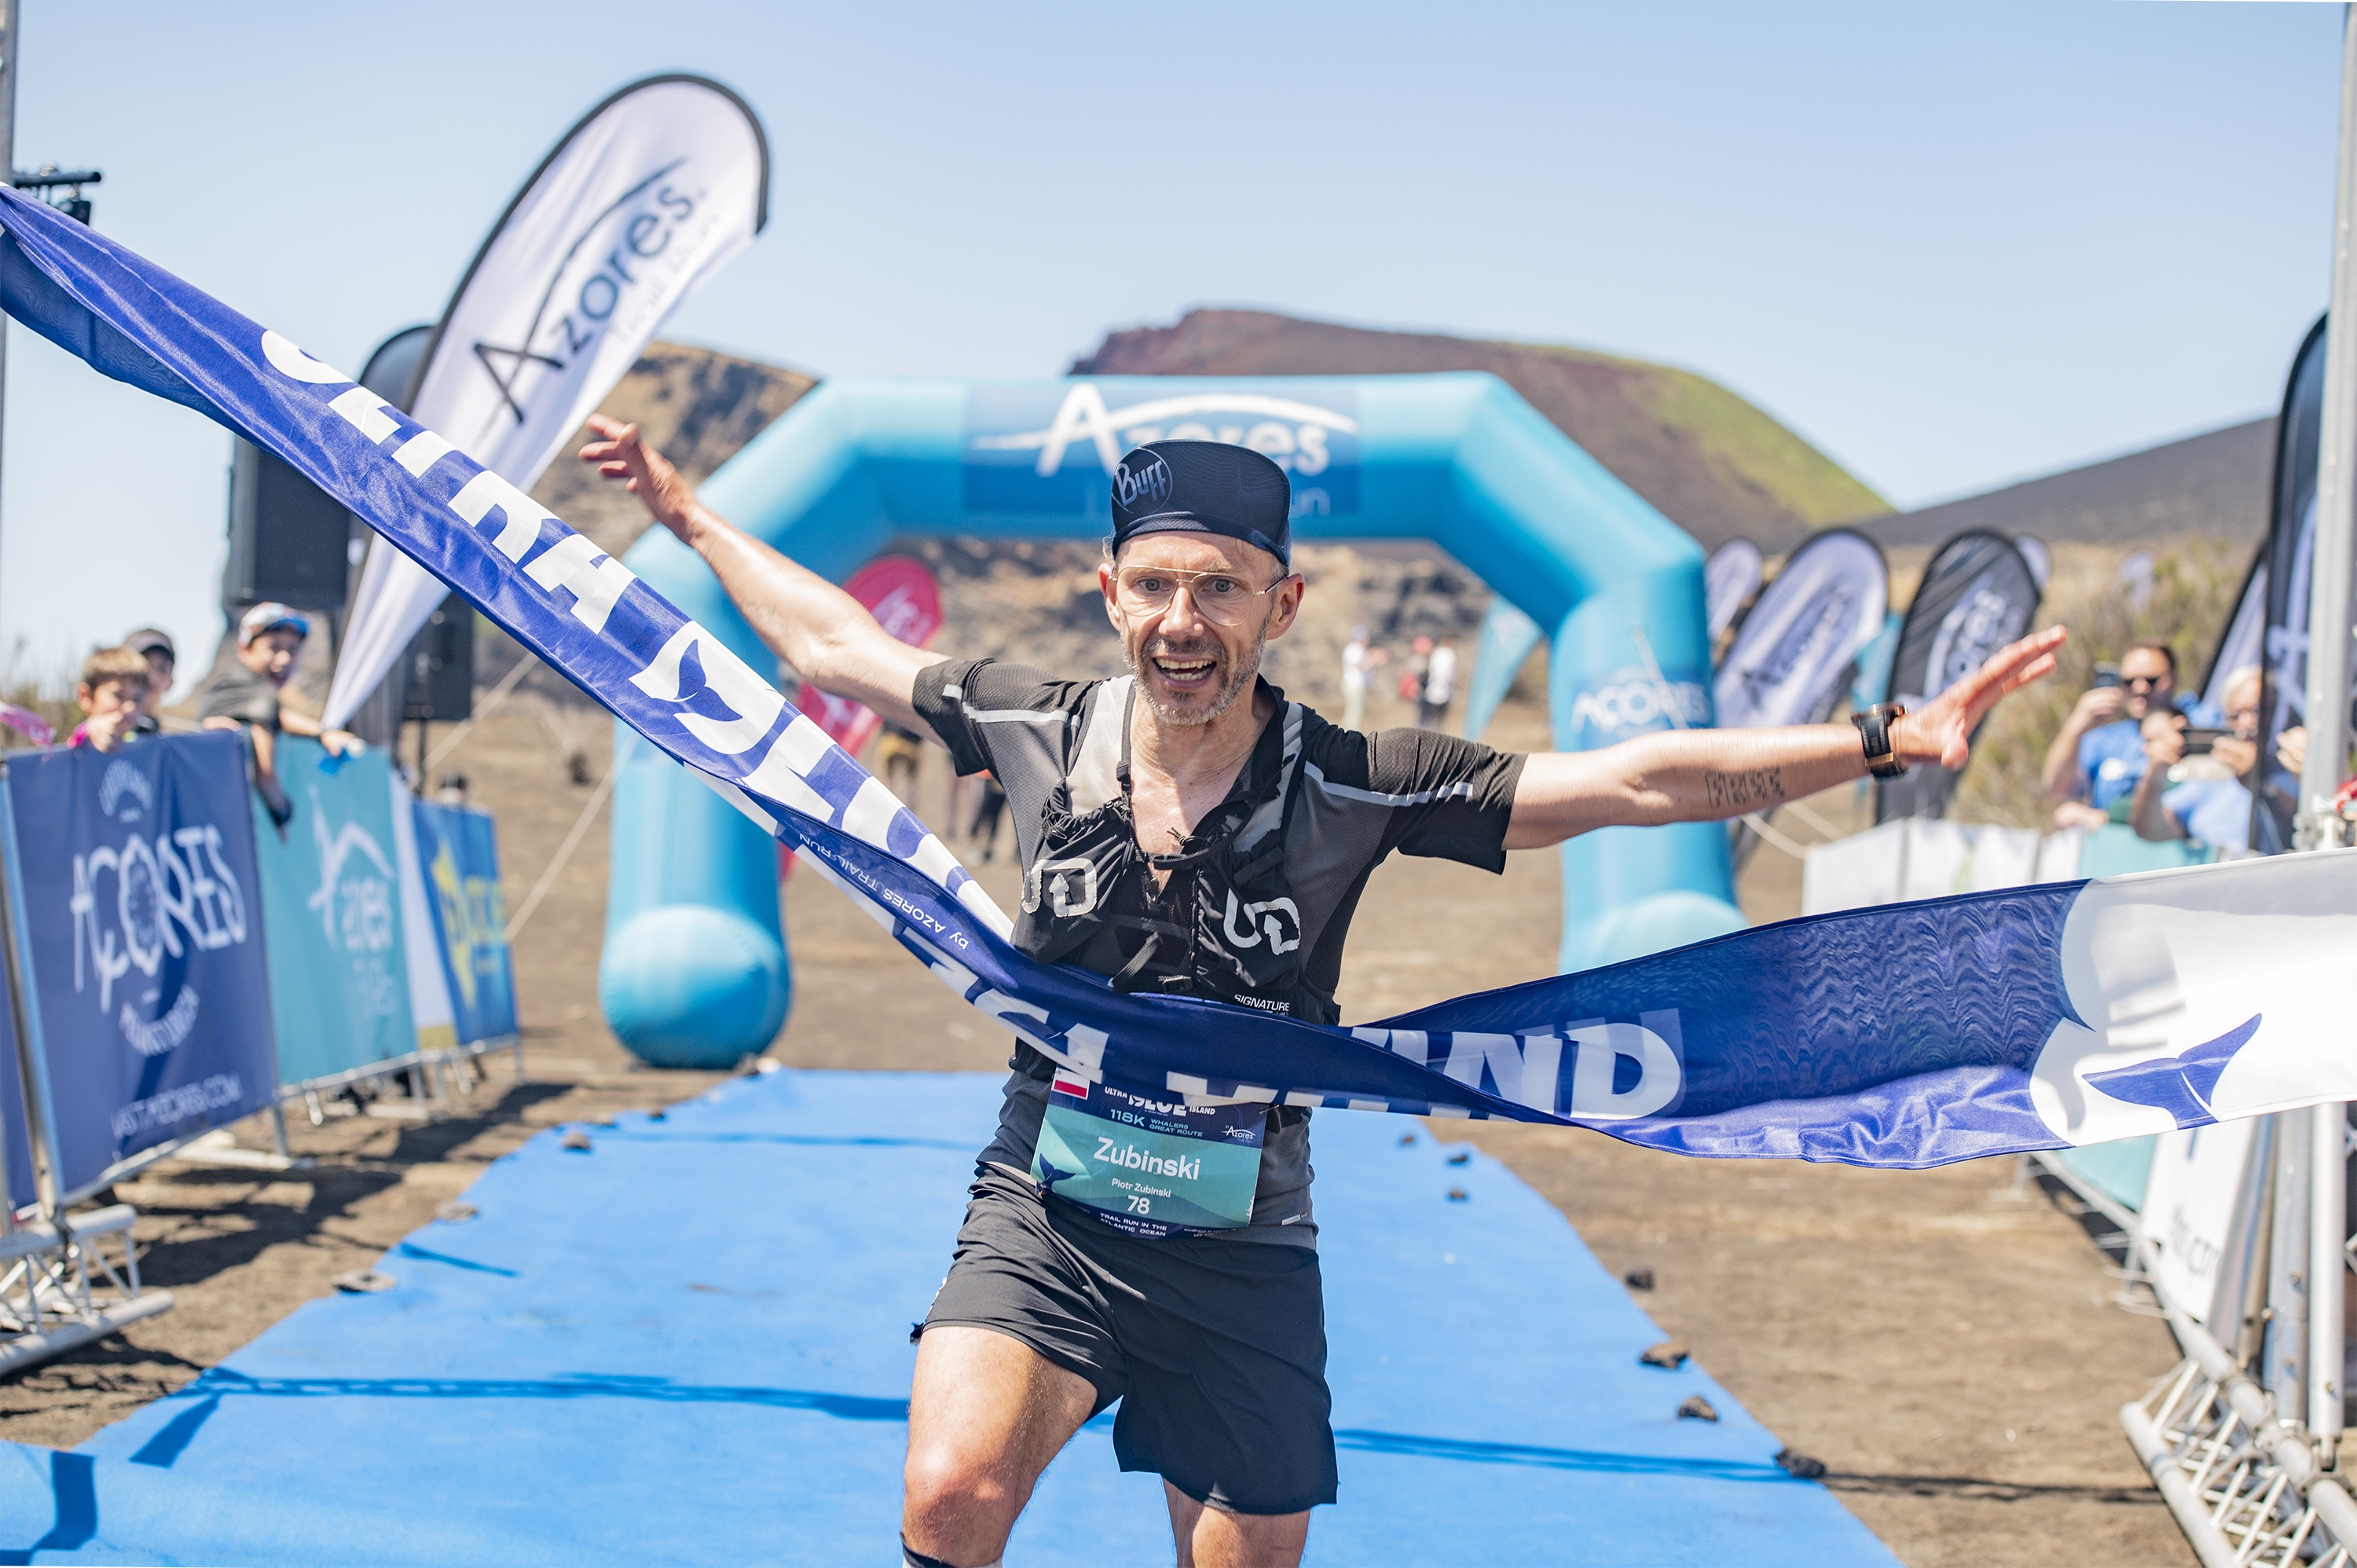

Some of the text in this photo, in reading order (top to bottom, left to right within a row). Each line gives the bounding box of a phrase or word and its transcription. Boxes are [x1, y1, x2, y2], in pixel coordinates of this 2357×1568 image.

[799, 833, 970, 951] by AZORES TRAIL RUN
[1234, 994, 1290, 1012] SIGNATURE
[1110, 1108, 1146, 1127] 118K
[1189, 1105, 1215, 1116] ISLAND
[1149, 1124, 1203, 1138] GREAT ROUTE
[1150, 1118, 1189, 1130] WHALERS
[1093, 1136, 1200, 1181] Zubinski
[1112, 1178, 1171, 1198] Piotr Zubinski
[1127, 1195, 1150, 1215] 78
[1100, 1212, 1121, 1223] TRAIL
[1100, 1218, 1166, 1236] ATLANTIC OCEAN
